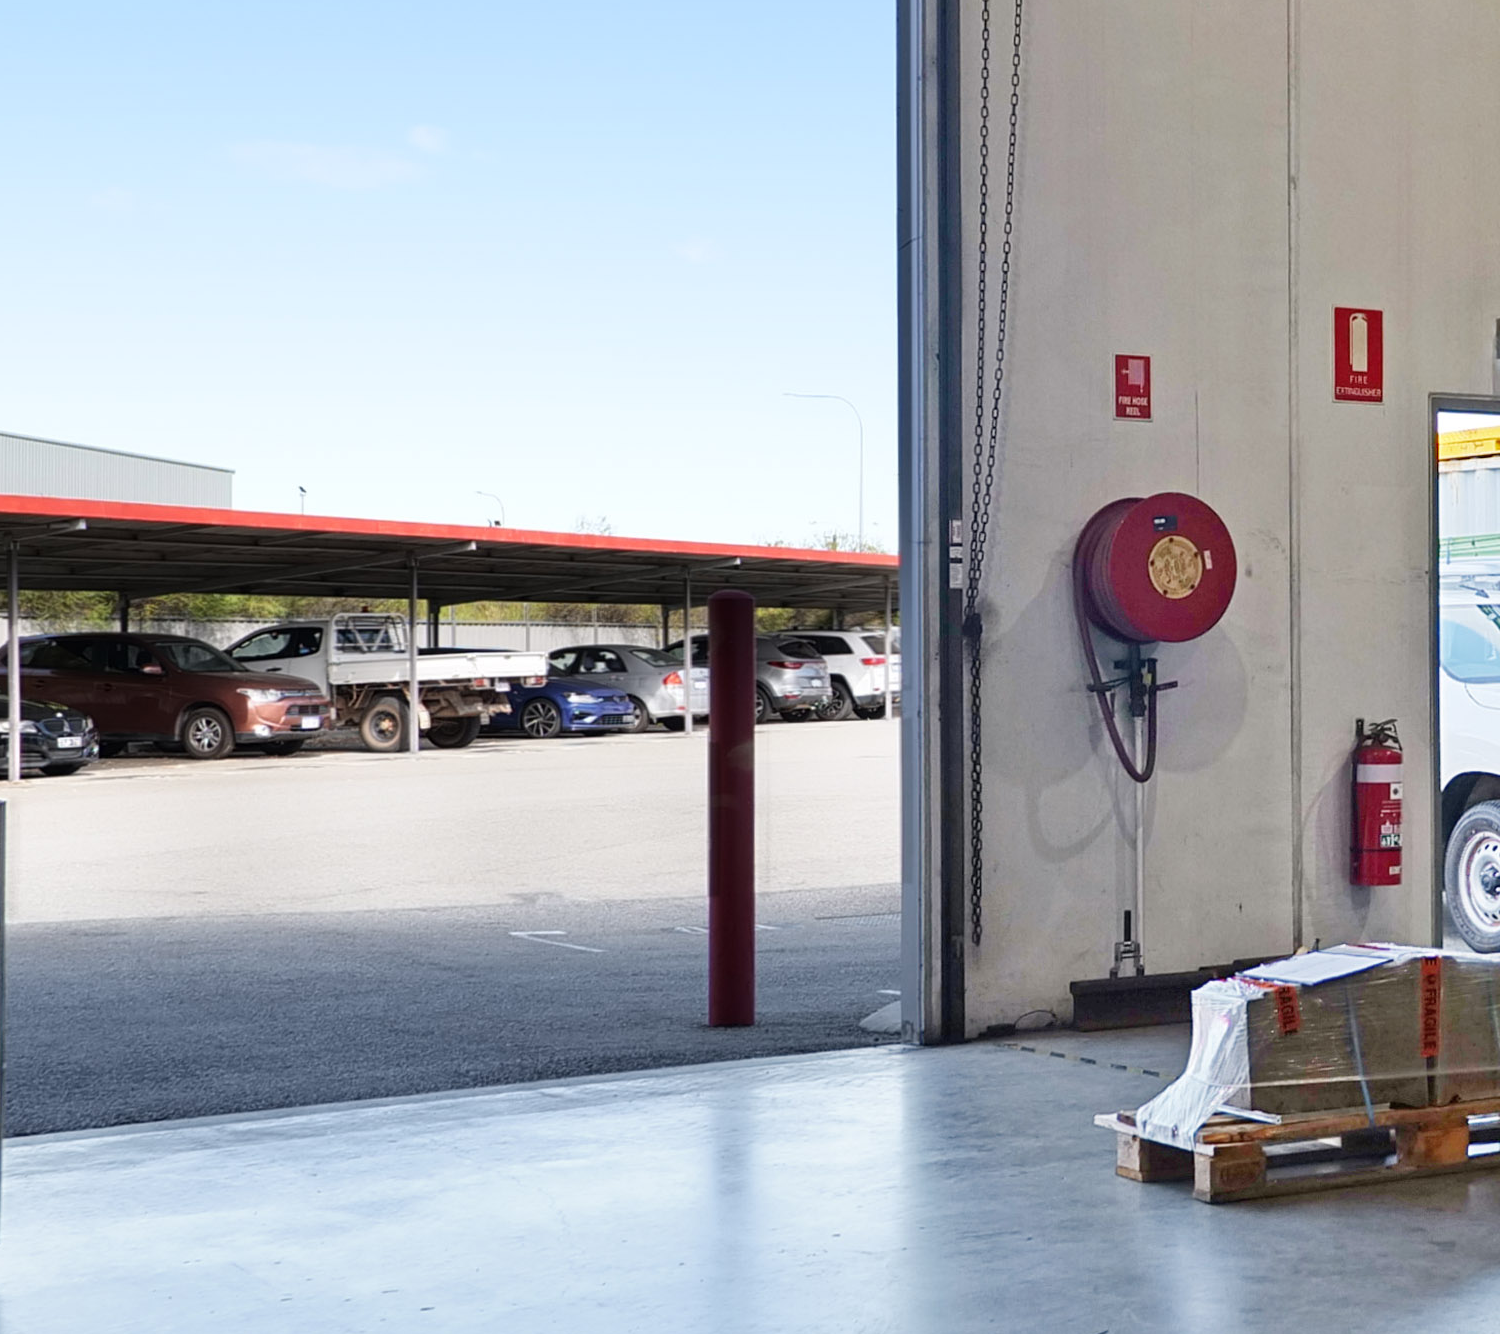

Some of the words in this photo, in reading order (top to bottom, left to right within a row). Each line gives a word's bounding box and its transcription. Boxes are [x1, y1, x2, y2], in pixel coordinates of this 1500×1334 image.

[1350, 375, 1368, 385] FIRE
[1336, 386, 1382, 397] EXTINGUISHER
[1118, 396, 1131, 406] FIRE
[1132, 396, 1148, 407] HOSE
[1126, 406, 1141, 416] REEL
[1423, 988, 1437, 1050] FRAGILE
